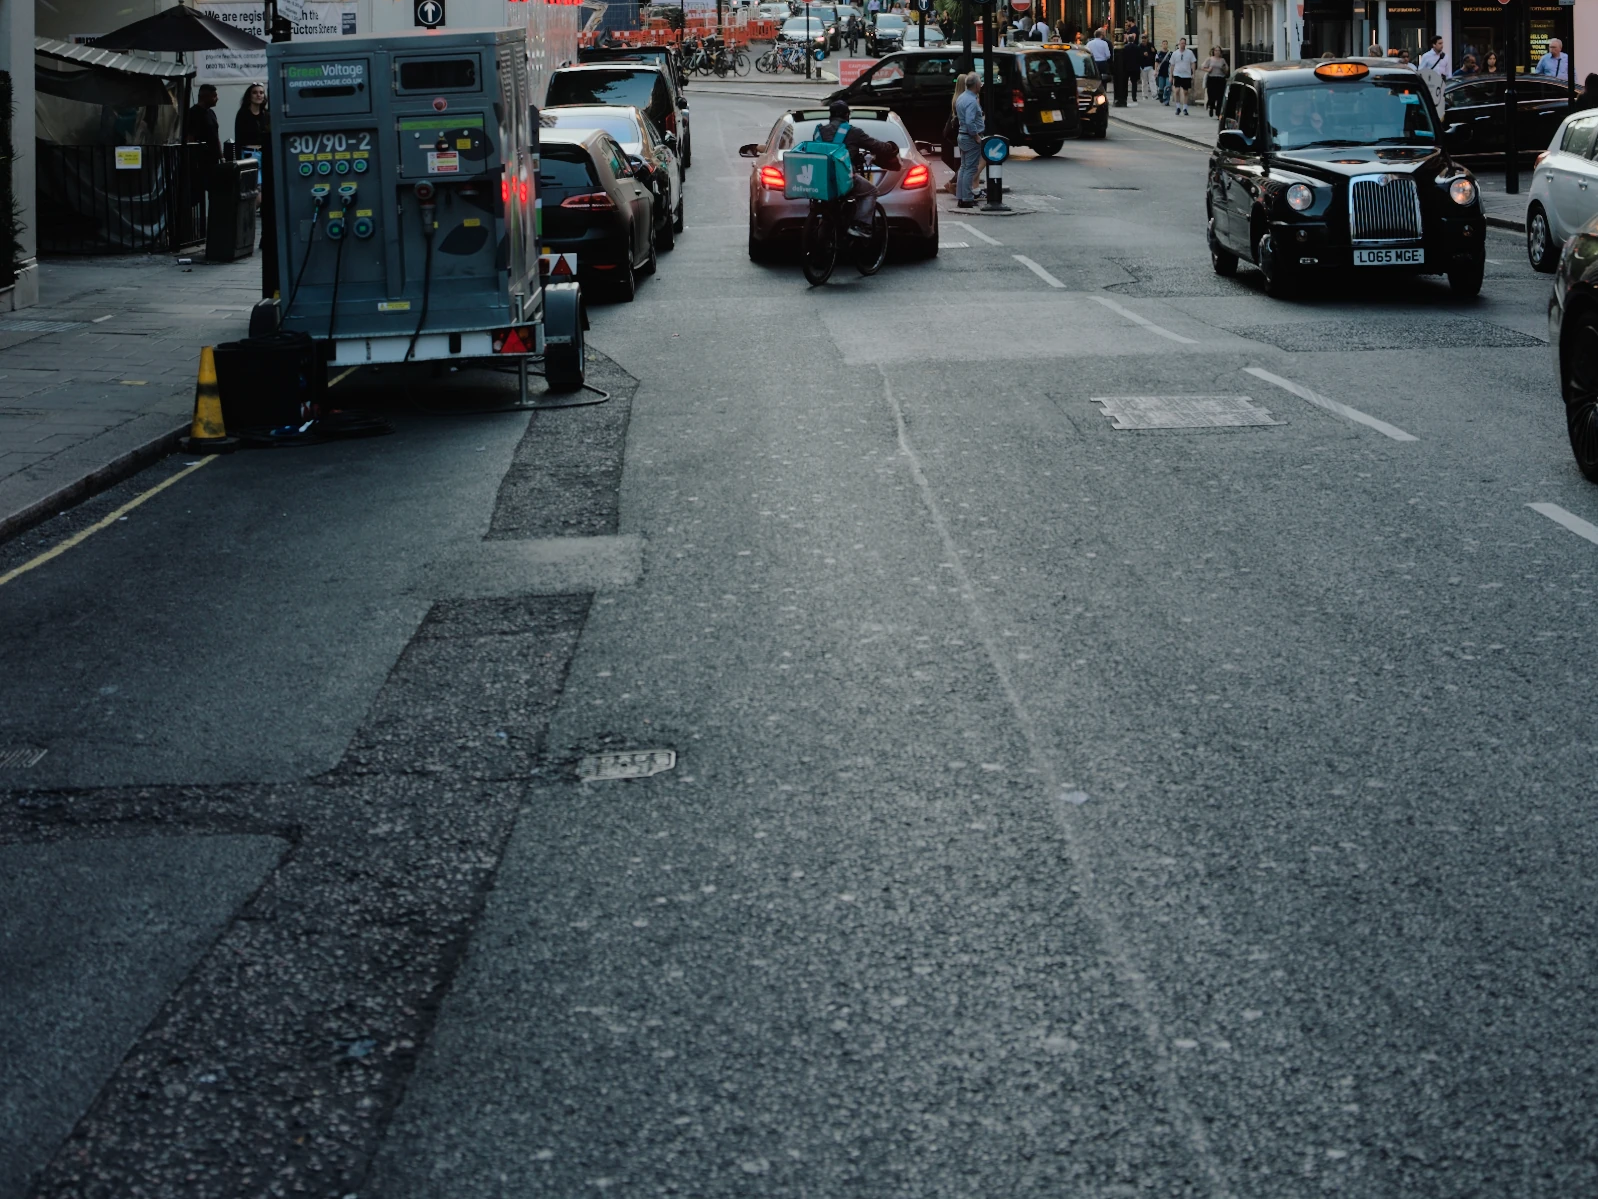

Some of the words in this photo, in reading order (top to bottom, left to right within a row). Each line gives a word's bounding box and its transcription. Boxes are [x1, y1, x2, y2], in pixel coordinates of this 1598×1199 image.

[222, 12, 237, 22] are
[239, 10, 266, 24] regist
[288, 64, 363, 78] GreenVoltage
[1328, 64, 1360, 74] TAXI
[289, 78, 363, 88] GREENVOLTAGE.CO.UK
[289, 132, 372, 154] 30/90-2
[791, 185, 819, 193] deliveroo
[1359, 250, 1392, 263] LO65
[1395, 249, 1420, 262] MGE
